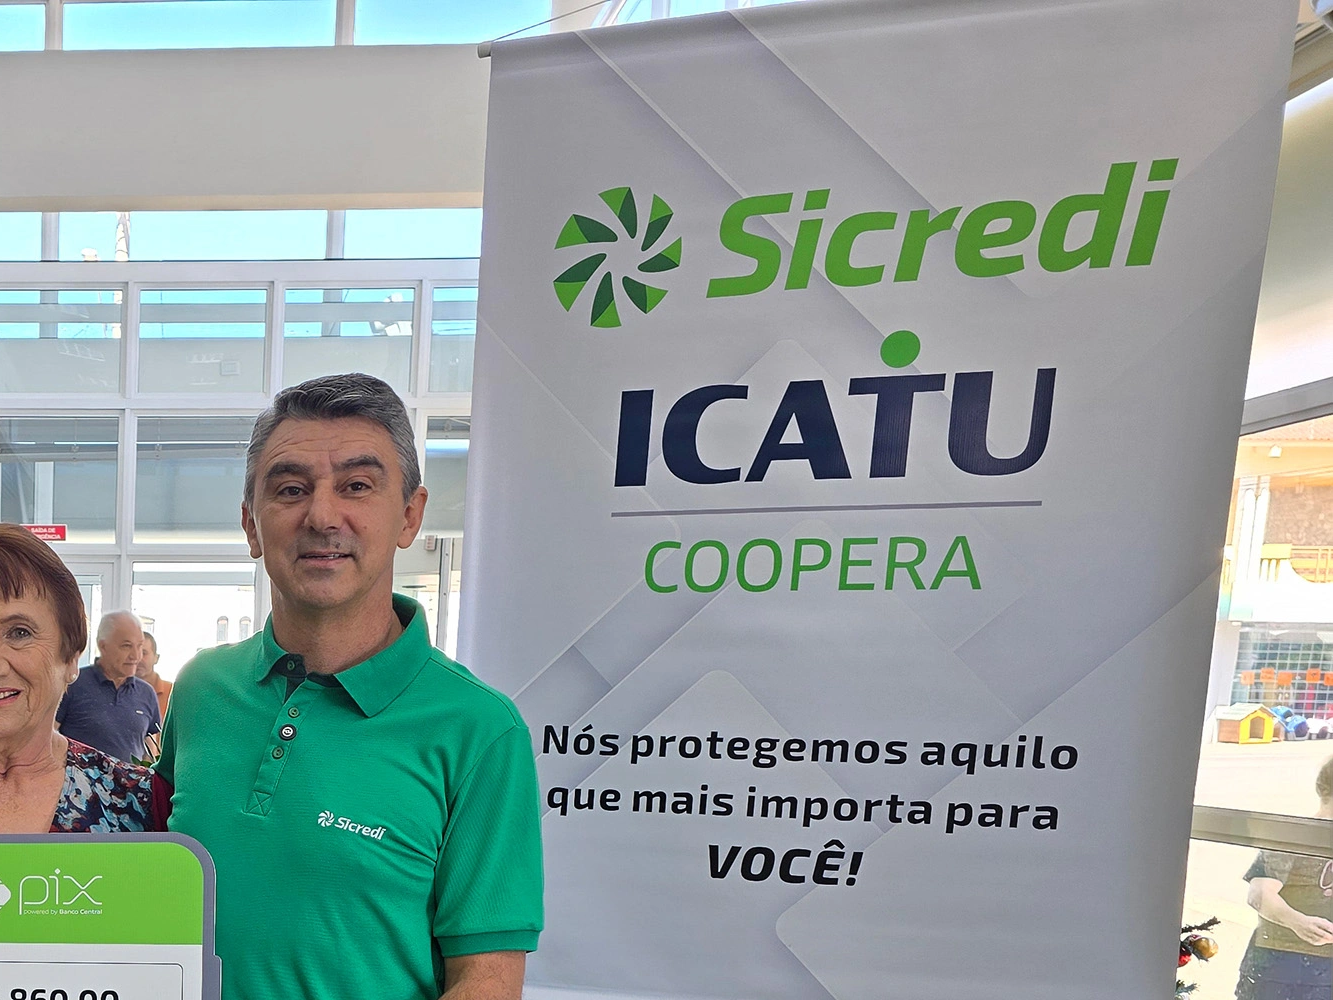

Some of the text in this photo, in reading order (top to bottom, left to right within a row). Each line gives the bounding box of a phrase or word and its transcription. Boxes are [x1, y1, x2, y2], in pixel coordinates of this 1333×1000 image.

[706, 158, 1180, 299] Sicredi
[613, 330, 1057, 487] ICATU
[643, 535, 982, 594] COOPERA
[542, 723, 1079, 775] Nós protegemos aquilo
[334, 816, 386, 840] Sicredi
[547, 784, 1060, 834] que mais importa para
[708, 839, 864, 887] VOCÊ!
[19, 868, 103, 915] pix
